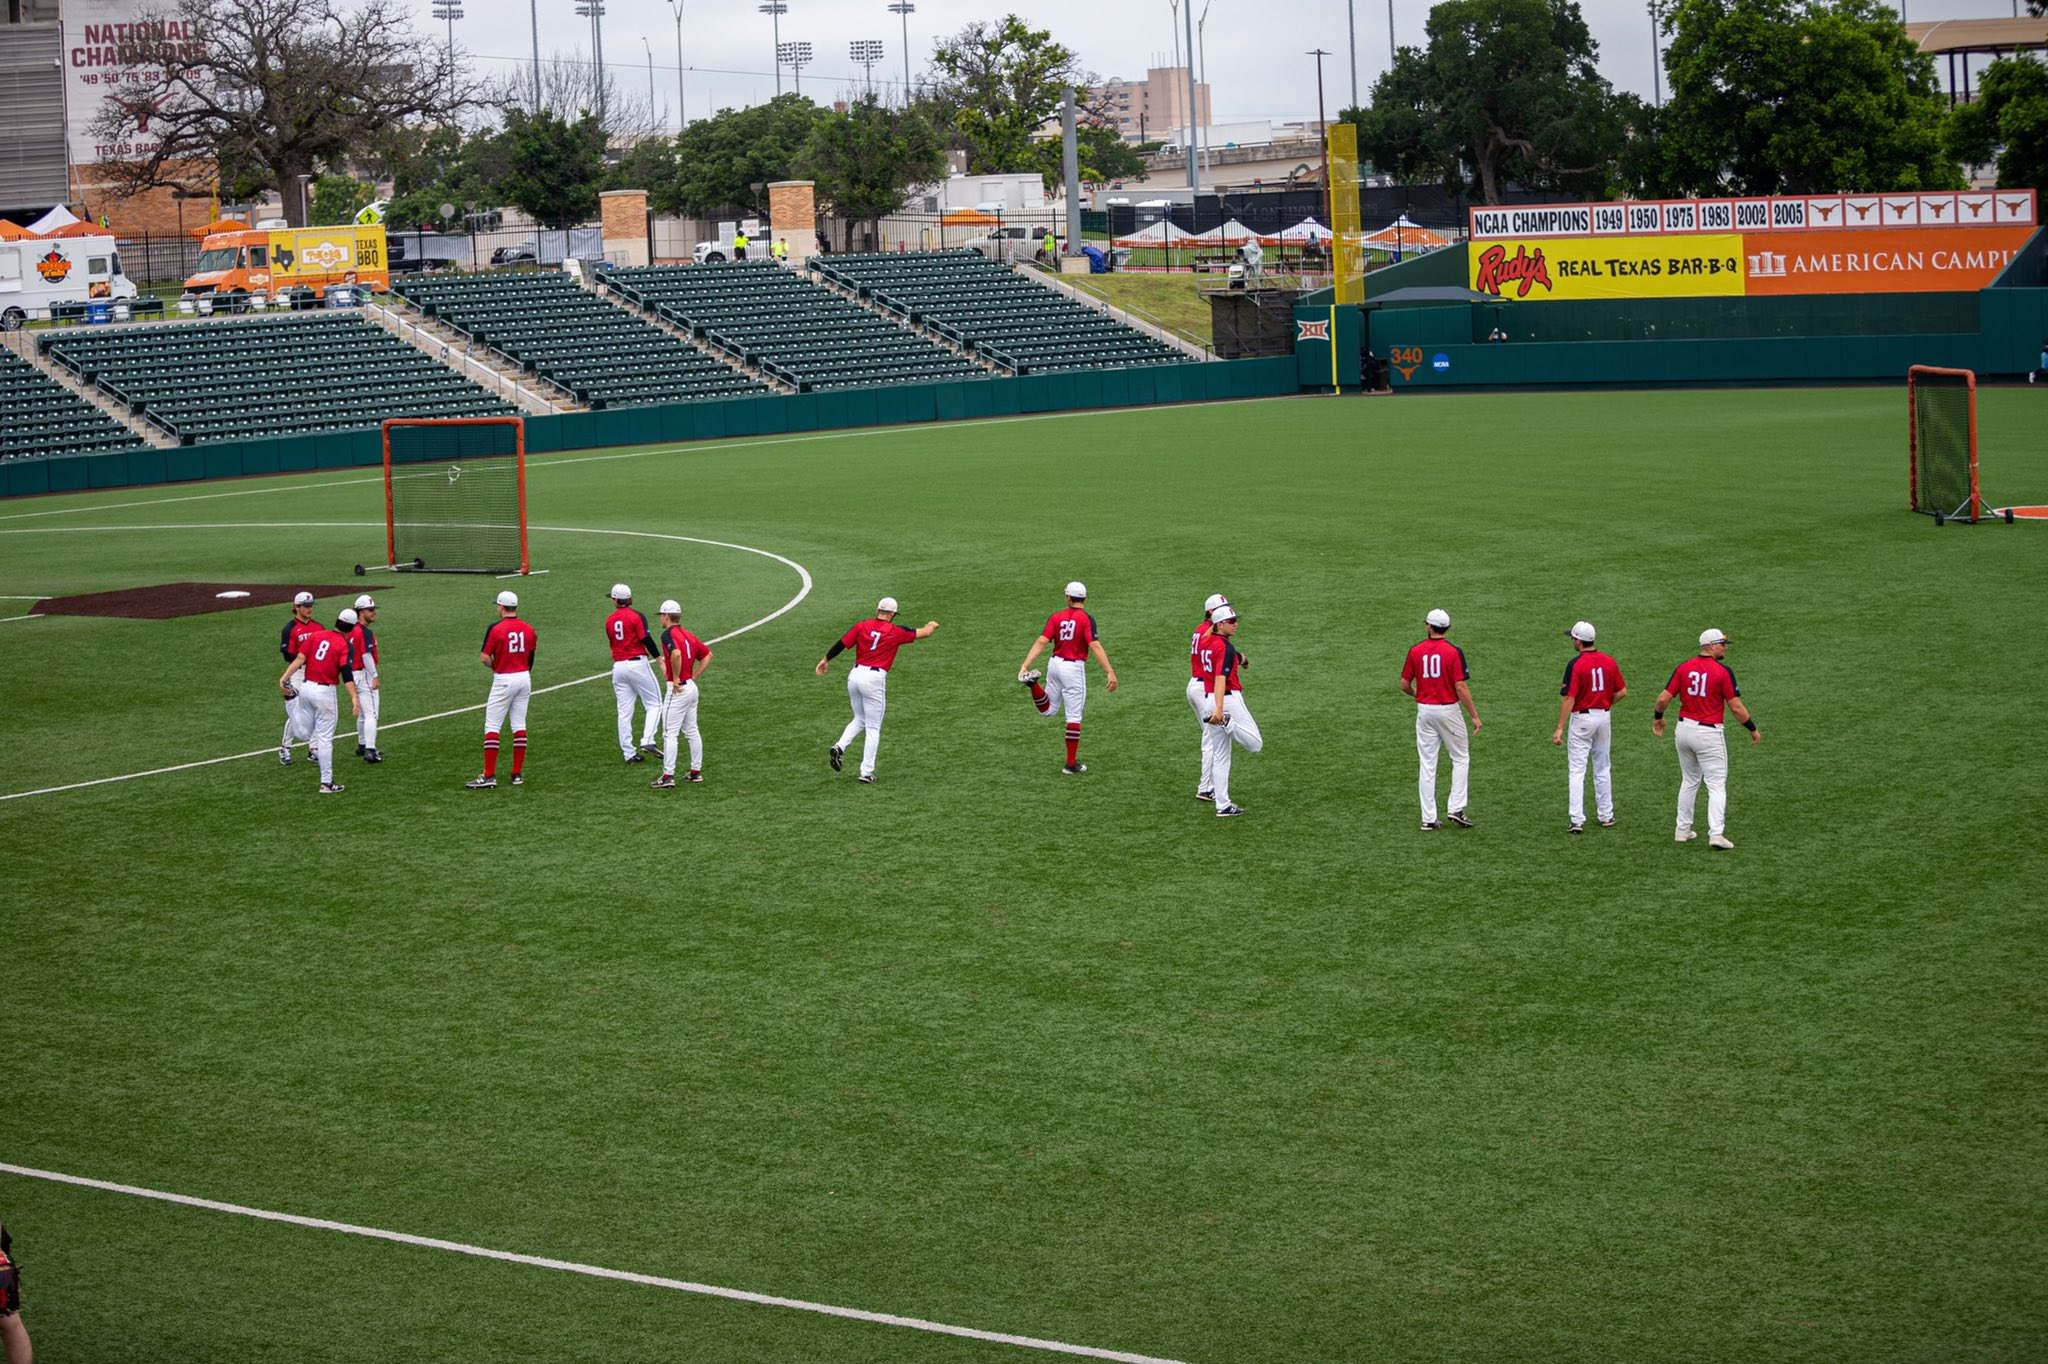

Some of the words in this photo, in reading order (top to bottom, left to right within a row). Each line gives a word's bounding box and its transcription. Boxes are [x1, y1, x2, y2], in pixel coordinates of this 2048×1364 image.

[85, 20, 191, 45] NATIONAL
[80, 74, 98, 84] '49
[101, 73, 119, 83] '50
[142, 71, 160, 82] '83
[94, 143, 132, 155] TEXAS
[1474, 213, 1509, 234] NCAA
[1512, 210, 1589, 233] CHAMPIONS
[1595, 209, 1623, 230] 1949
[1630, 208, 1658, 229] 1950
[1666, 207, 1694, 228] 1975
[1702, 205, 1730, 226] 1983
[1737, 204, 1767, 226] 2002
[1774, 203, 1803, 225] 2005
[356, 239, 378, 250] TEXAS
[357, 249, 379, 267] BBQ
[1557, 260, 1603, 277] REAL
[1604, 259, 1662, 277] TEXAS
[1667, 257, 1738, 276] BAR-B-Q
[1792, 251, 1925, 273] AMERICAN
[1476, 244, 1553, 298] Rudy's
[1300, 322, 1327, 338] XII
[1390, 347, 1423, 364] 340
[614, 620, 624, 641] 9
[870, 630, 881, 651] 7
[1060, 619, 1076, 641] 29
[315, 639, 330, 661] 8
[508, 631, 526, 653] 21
[684, 639, 691, 659] 1
[1200, 649, 1213, 673] 15
[1422, 653, 1441, 679] 10
[1591, 667, 1604, 692] 11
[1687, 671, 1708, 698] 31
